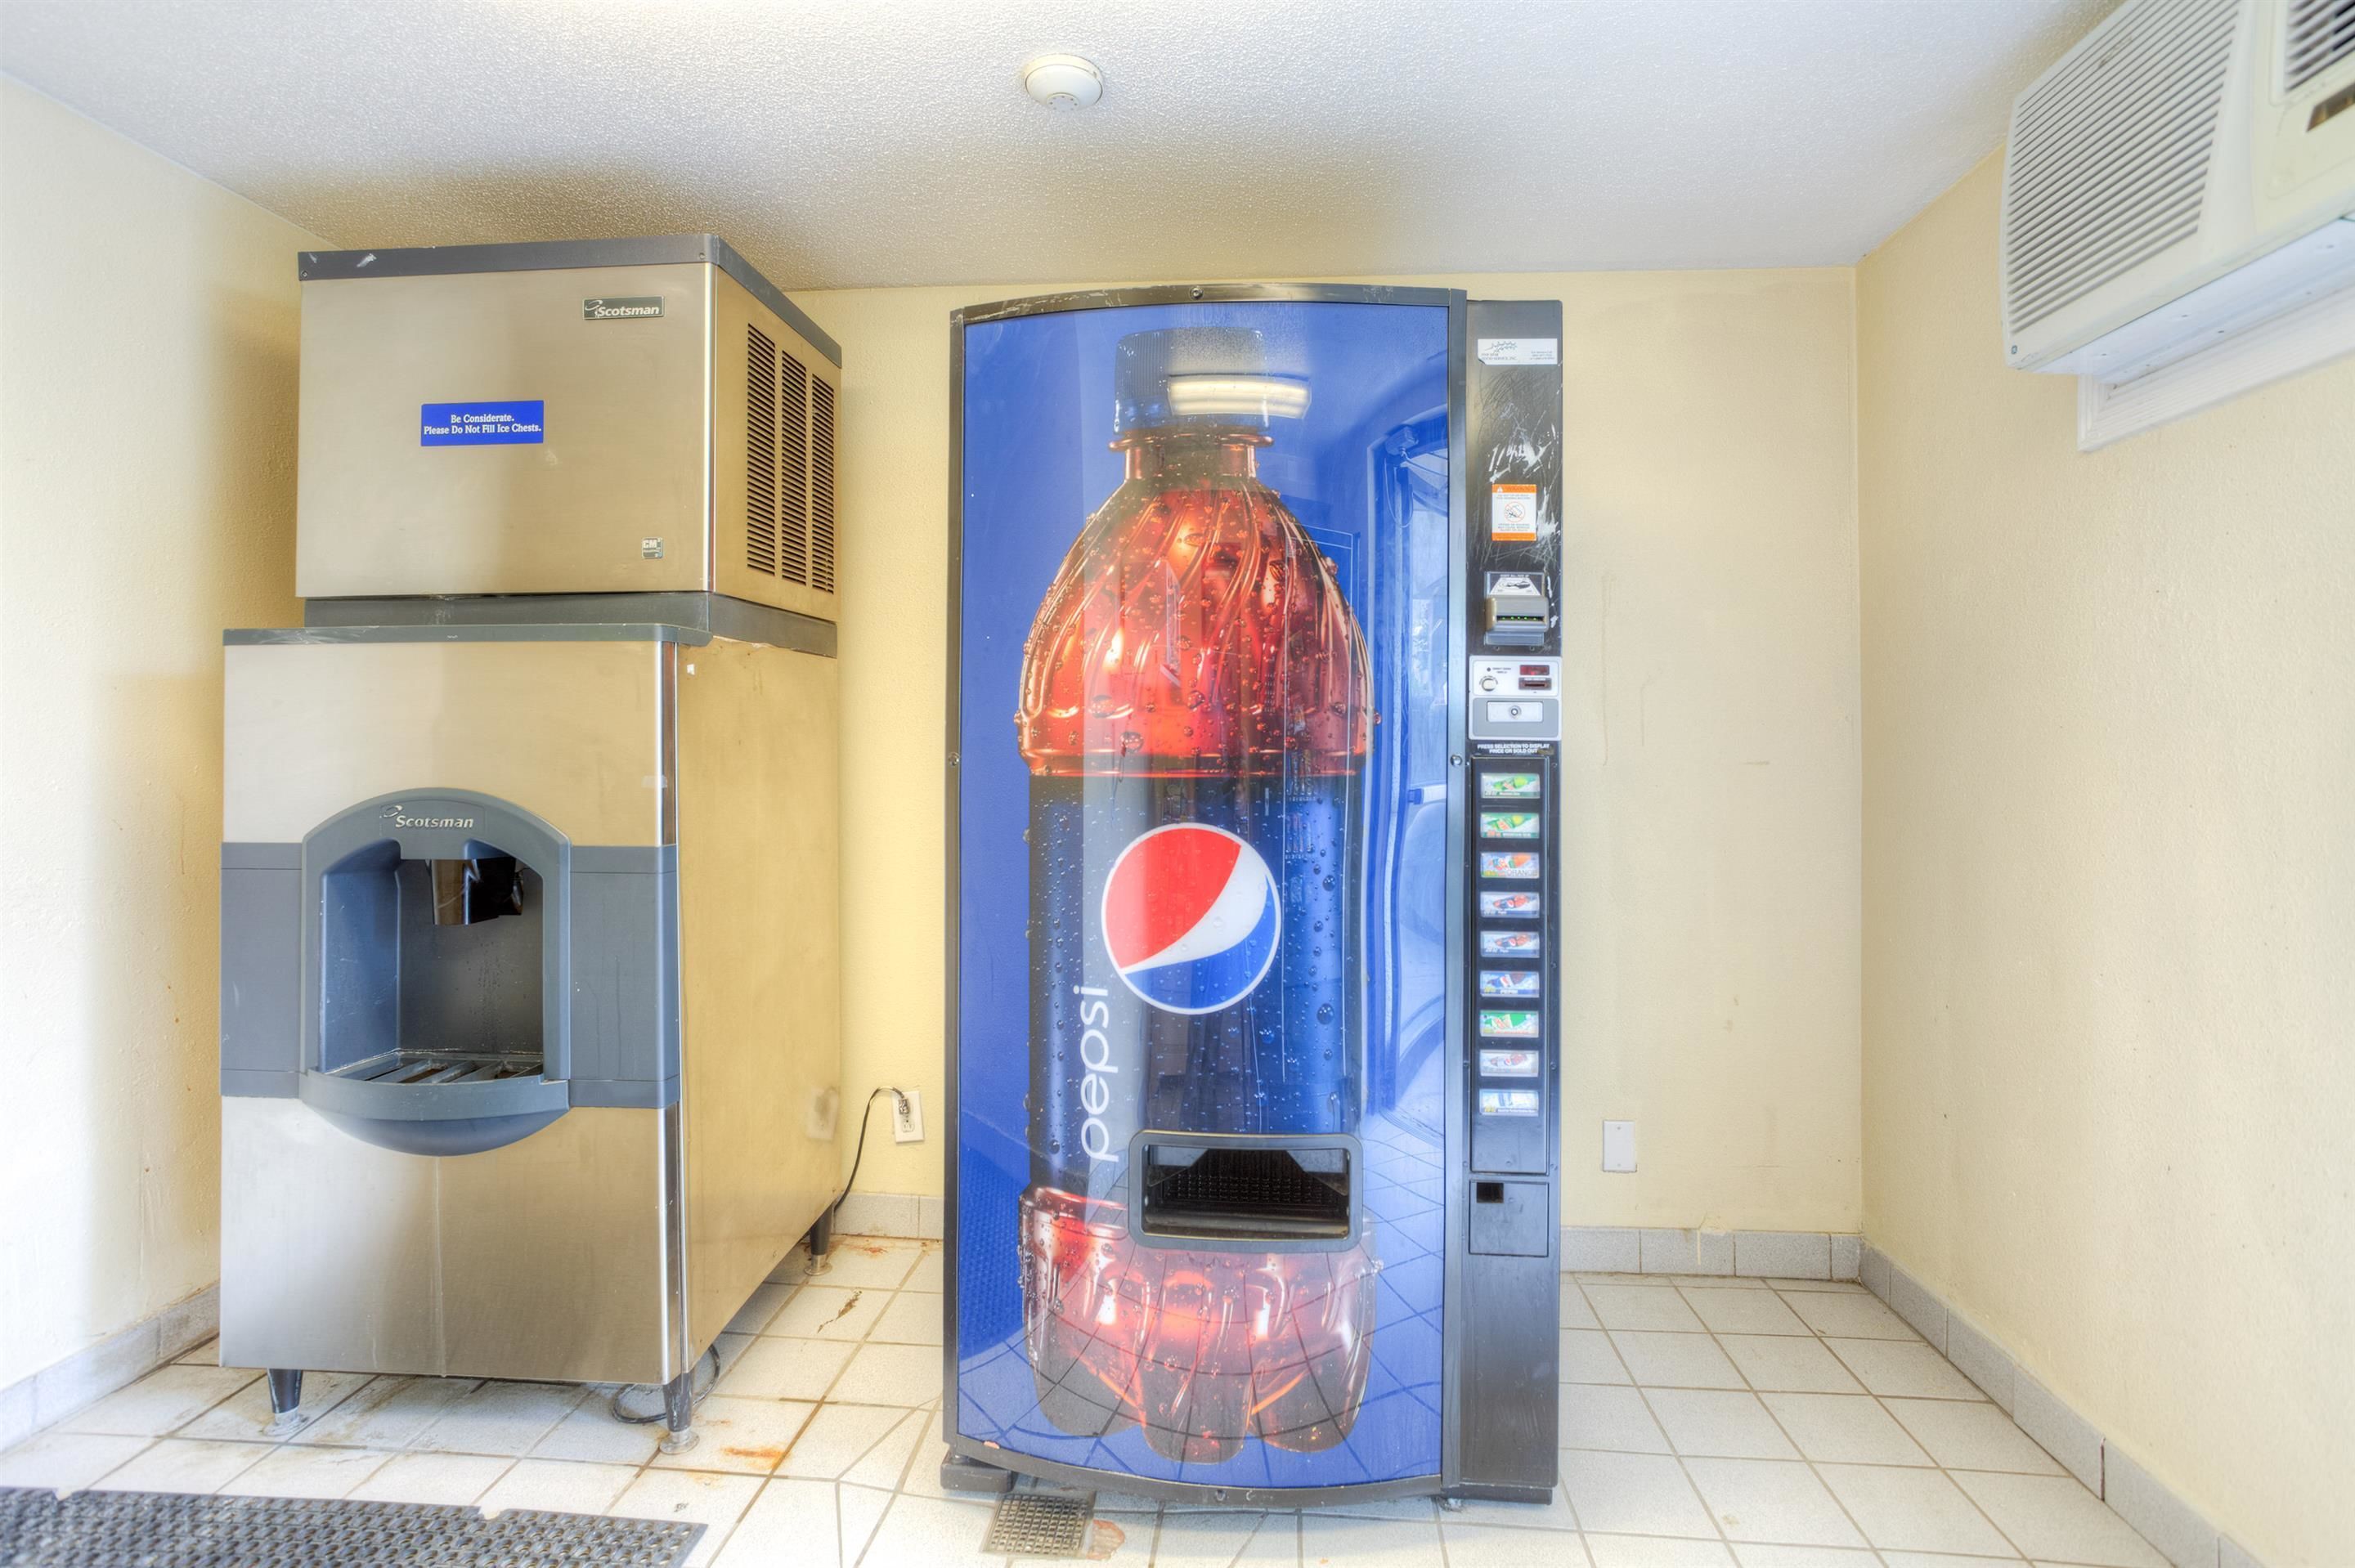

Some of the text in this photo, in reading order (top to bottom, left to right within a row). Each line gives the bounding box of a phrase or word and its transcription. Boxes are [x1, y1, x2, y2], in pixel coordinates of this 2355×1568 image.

[598, 306, 659, 316] Scotsman
[451, 414, 514, 423] Be Considerate.
[424, 423, 541, 435] Please Do Not Fill Ice Chests.
[396, 815, 473, 828] Scotsman
[1074, 985, 1119, 1163] pepsi
